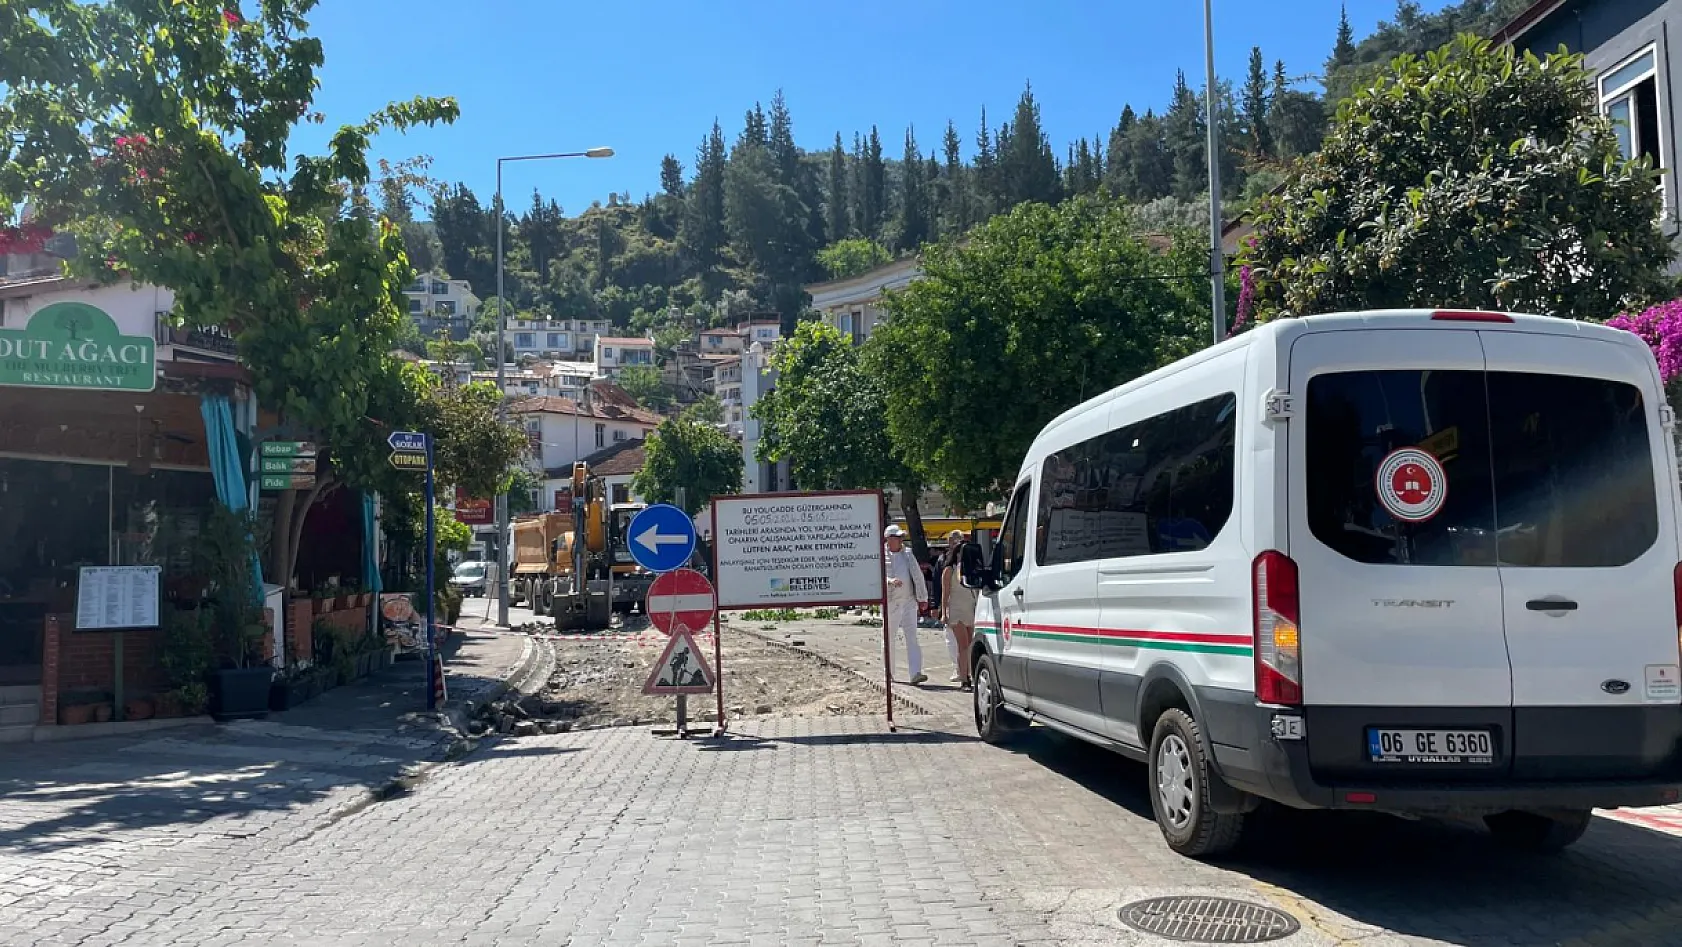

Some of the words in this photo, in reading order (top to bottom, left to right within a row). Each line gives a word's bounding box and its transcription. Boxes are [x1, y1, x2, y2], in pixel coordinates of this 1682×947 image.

[0, 338, 53, 360] DUT
[58, 338, 148, 364] AĞACI
[23, 372, 124, 386] RESTAURANT
[394, 455, 425, 466] OTOPARK
[264, 479, 284, 487] Pide
[760, 525, 797, 534] ARASINDA
[863, 522, 872, 531] VE
[795, 543, 813, 551] PARK
[789, 576, 830, 585] FETHİYE
[789, 584, 831, 592] BELEDİYESİ
[1370, 598, 1455, 607] TRANSIT
[1381, 732, 1404, 753] 06
[1416, 732, 1438, 753] GE
[1446, 733, 1488, 753] 6360
